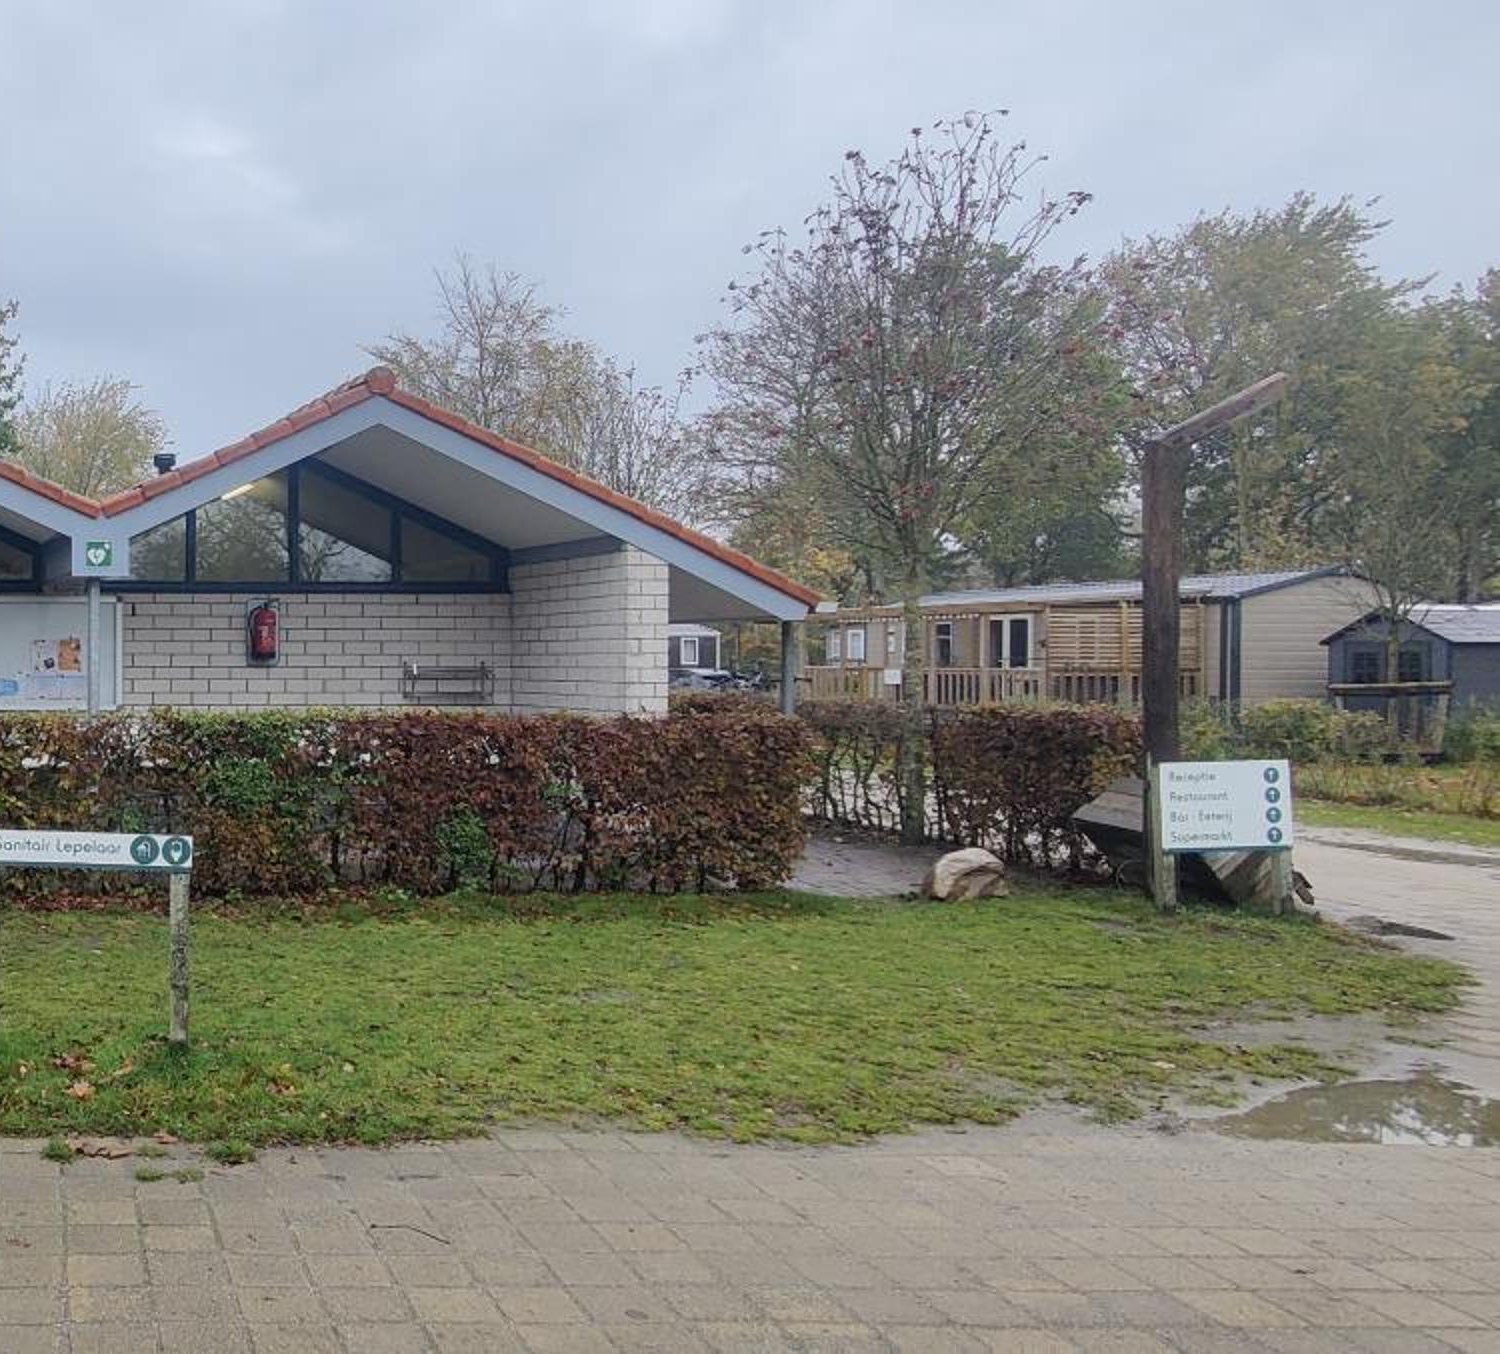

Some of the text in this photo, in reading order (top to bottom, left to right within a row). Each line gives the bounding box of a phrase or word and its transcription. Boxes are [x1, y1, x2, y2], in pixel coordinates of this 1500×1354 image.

[1169, 791, 1228, 802] Restaurant
[1170, 811, 1189, 823] Bar
[1170, 830, 1233, 843] Supermarkt
[56, 839, 121, 857] Lepelaar
